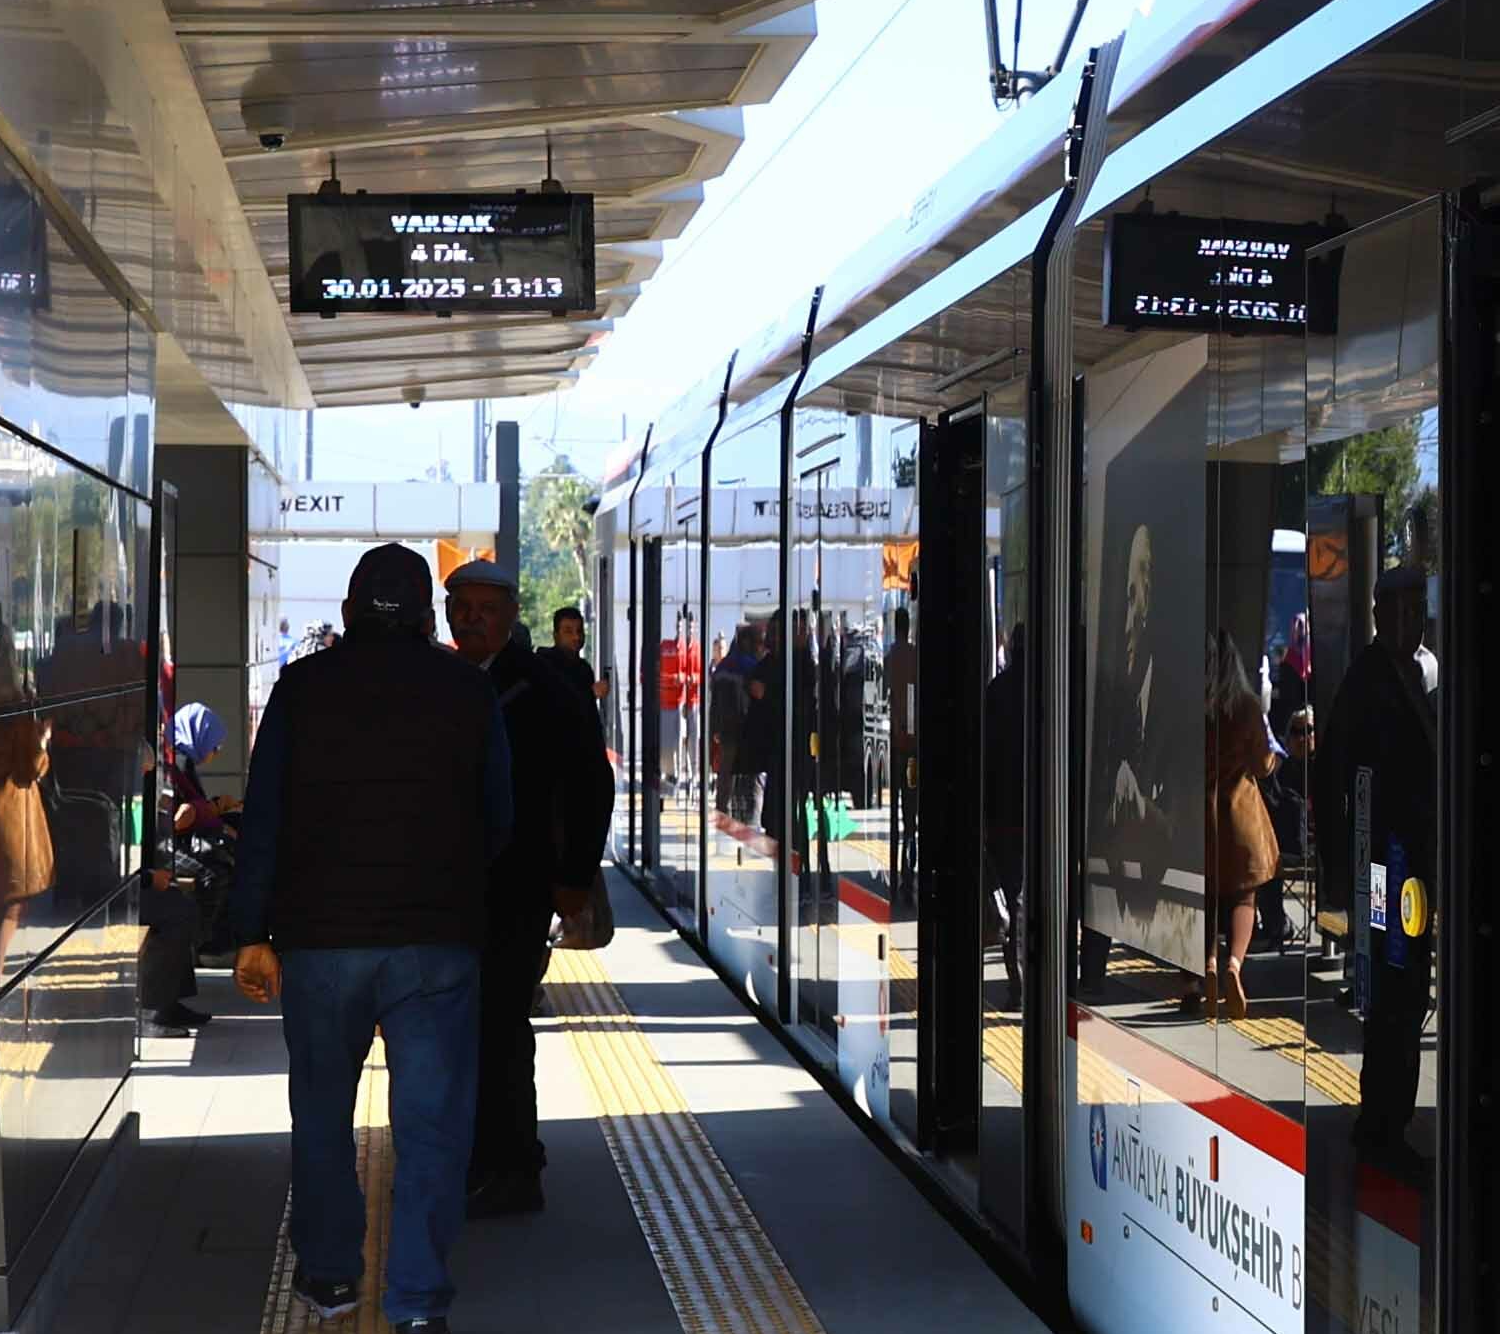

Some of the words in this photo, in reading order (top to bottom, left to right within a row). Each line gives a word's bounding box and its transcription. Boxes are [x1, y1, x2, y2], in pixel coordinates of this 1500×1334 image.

[321, 278, 466, 299] 30.01.2025
[490, 277, 565, 299] 13:13
[1111, 1129, 1170, 1216] ANTALYA
[1174, 1155, 1284, 1299] BÜYÜKŞEHİR
